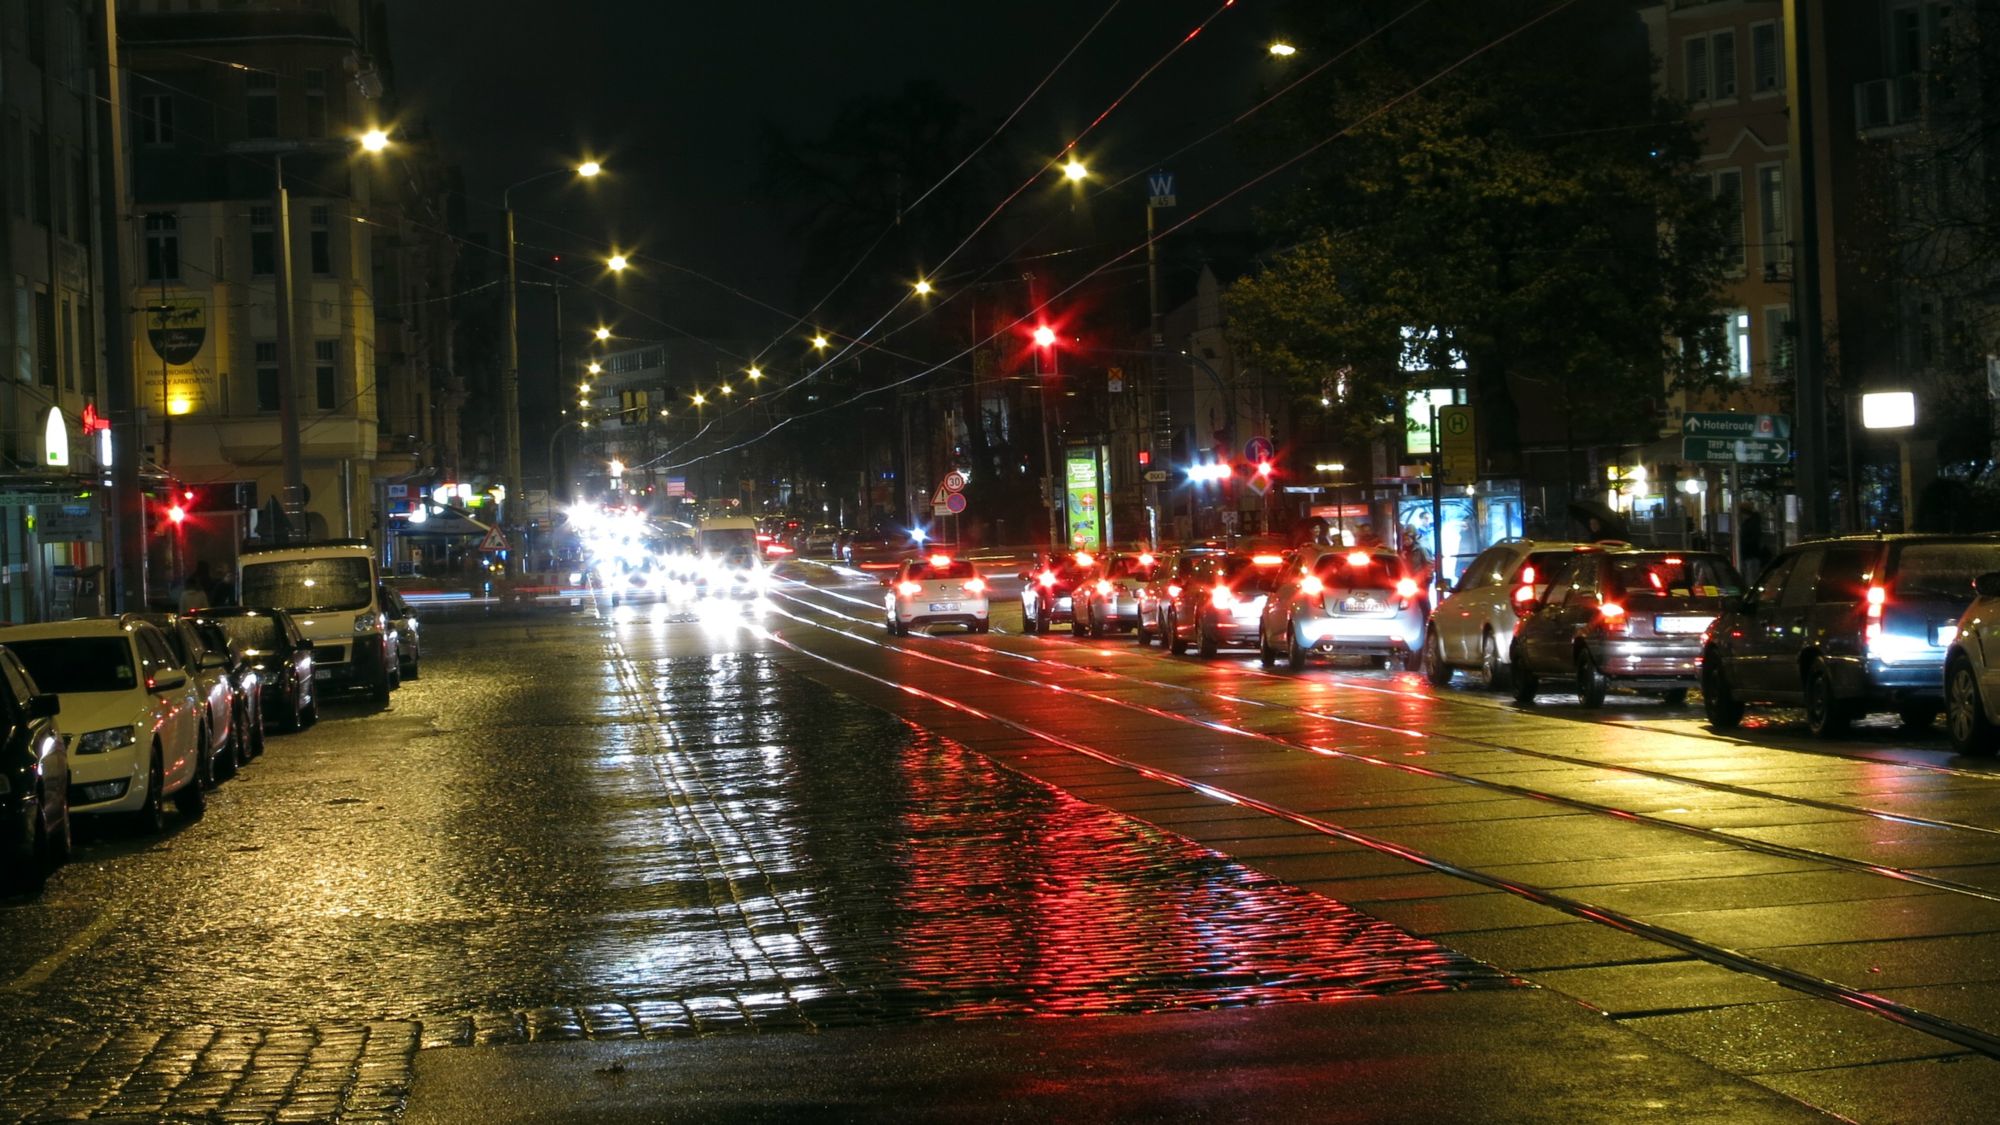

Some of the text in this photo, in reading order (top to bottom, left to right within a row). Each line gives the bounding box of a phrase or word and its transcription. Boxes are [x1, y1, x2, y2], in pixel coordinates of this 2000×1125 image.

[1149, 176, 1172, 196] W
[147, 367, 209, 376] FERIEWOHNUNGEN
[1452, 417, 1464, 429] H
[1703, 420, 1769, 432] Hotelroute C
[1707, 451, 1733, 460] Dresden
[949, 477, 960, 486] 30
[85, 581, 95, 594] P
